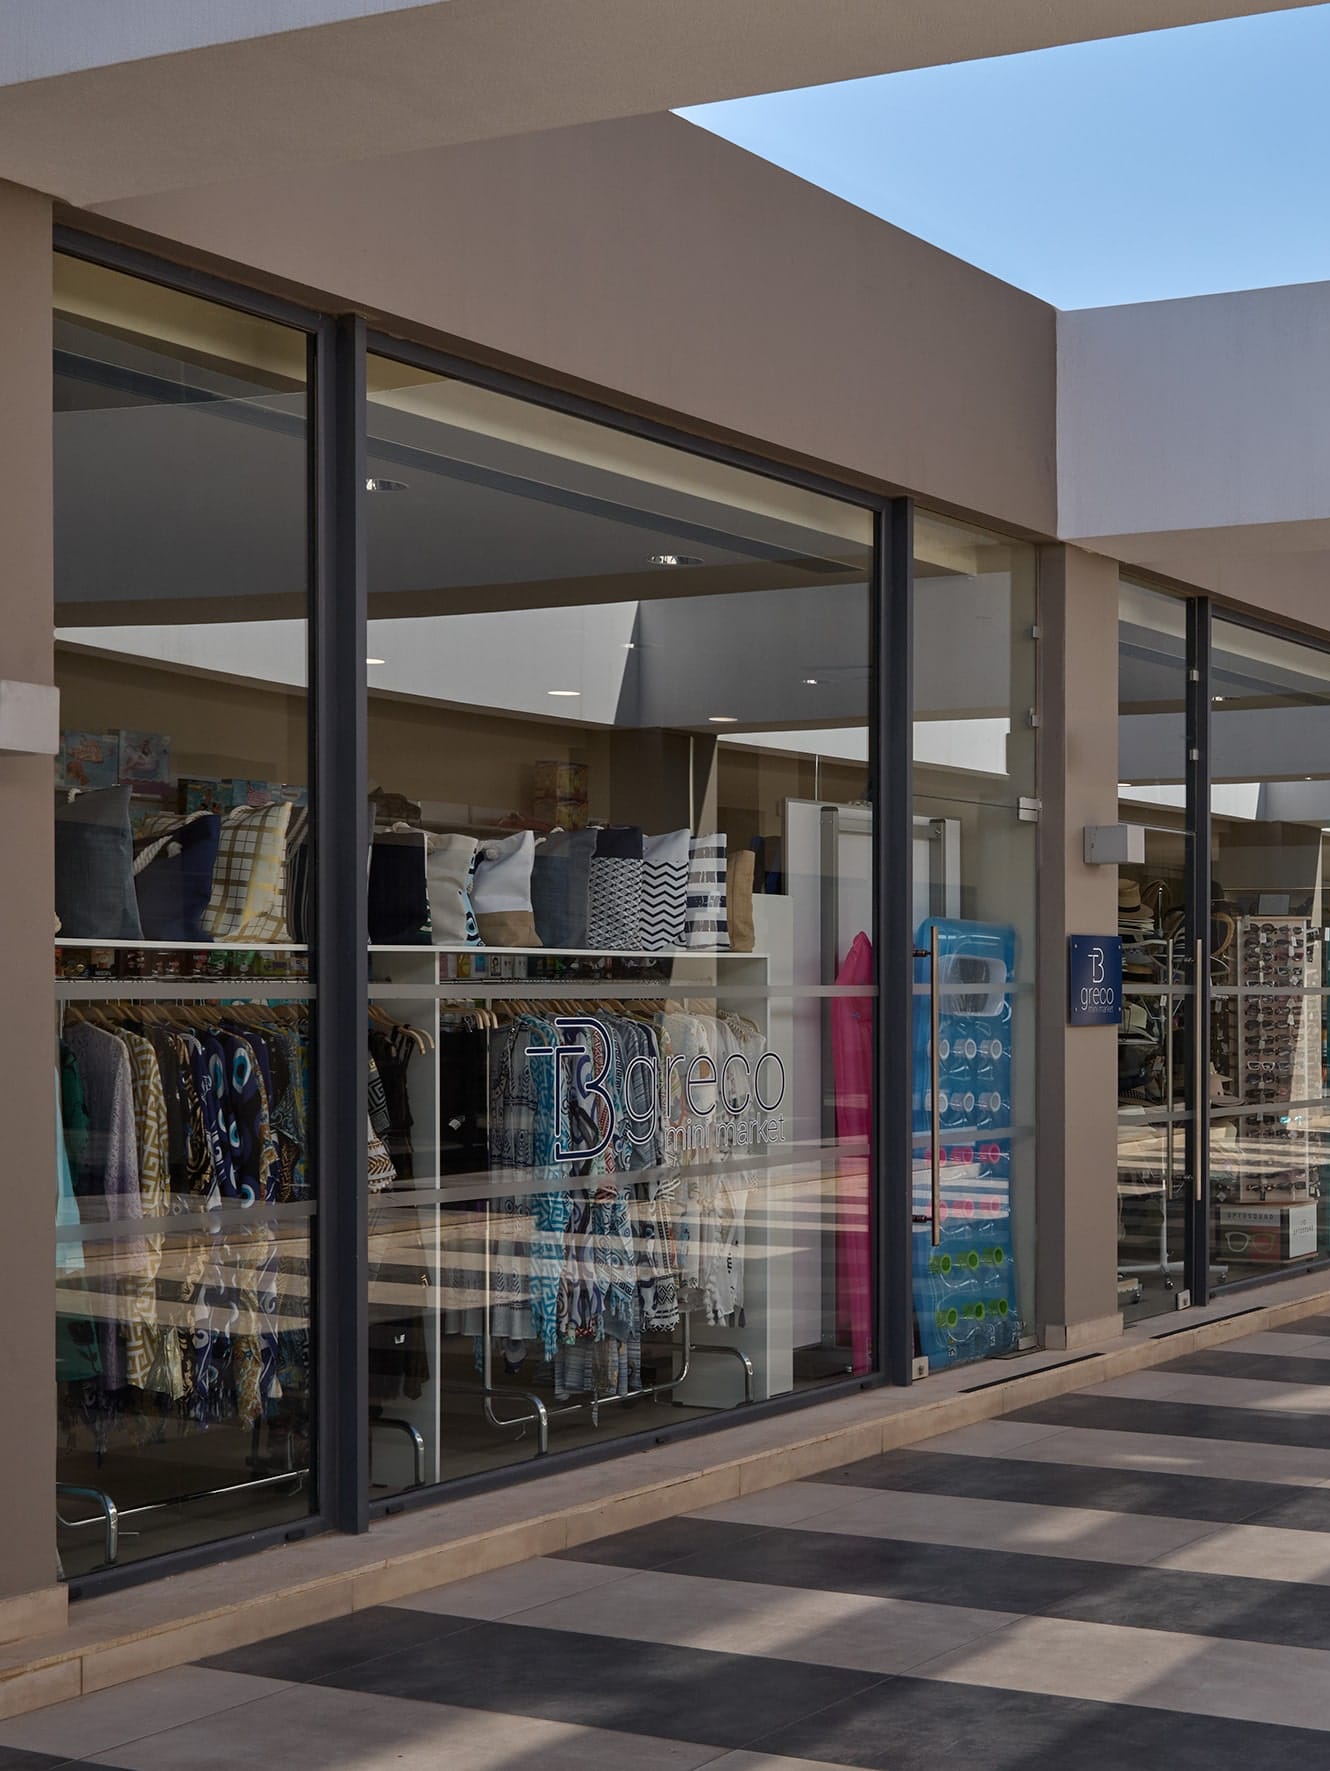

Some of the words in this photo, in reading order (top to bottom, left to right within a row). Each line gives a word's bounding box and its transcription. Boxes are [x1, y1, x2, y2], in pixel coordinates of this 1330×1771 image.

[1080, 987, 1114, 1010] greco
[624, 1050, 786, 1145] greco
[663, 1117, 710, 1152] mini
[715, 1113, 786, 1148] market
